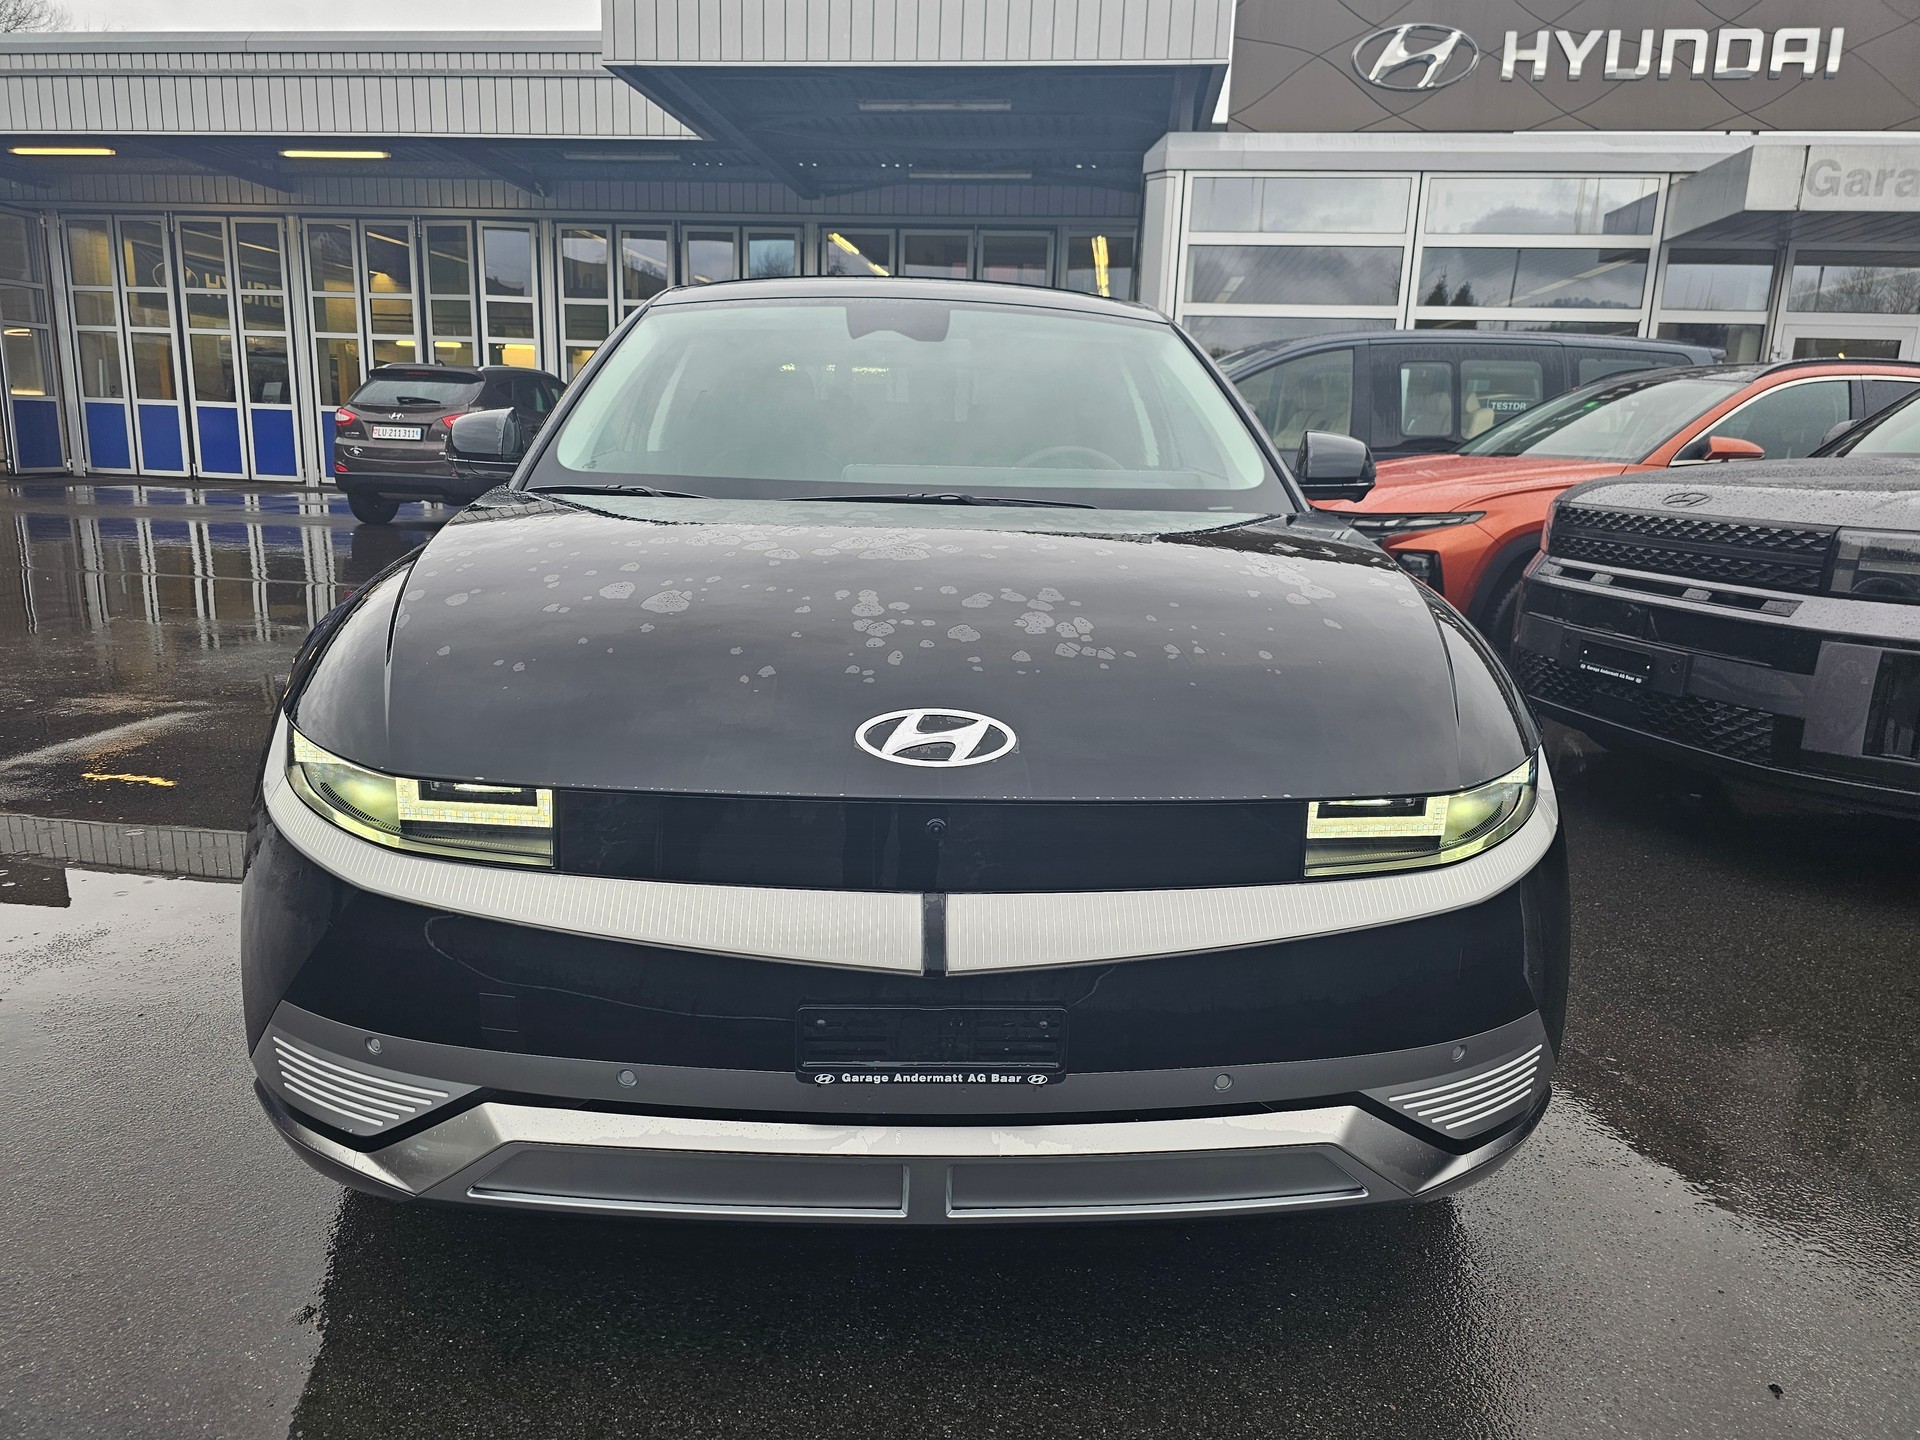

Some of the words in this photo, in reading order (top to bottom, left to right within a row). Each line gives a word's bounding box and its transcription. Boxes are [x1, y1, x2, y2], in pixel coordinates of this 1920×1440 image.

[1500, 27, 1844, 82] HYUNDAI
[1806, 159, 1920, 198] Gara
[841, 1073, 889, 1084] Garage
[893, 1073, 963, 1083] Andermatt
[967, 1073, 987, 1083] AG
[991, 1073, 1022, 1083] Baar
